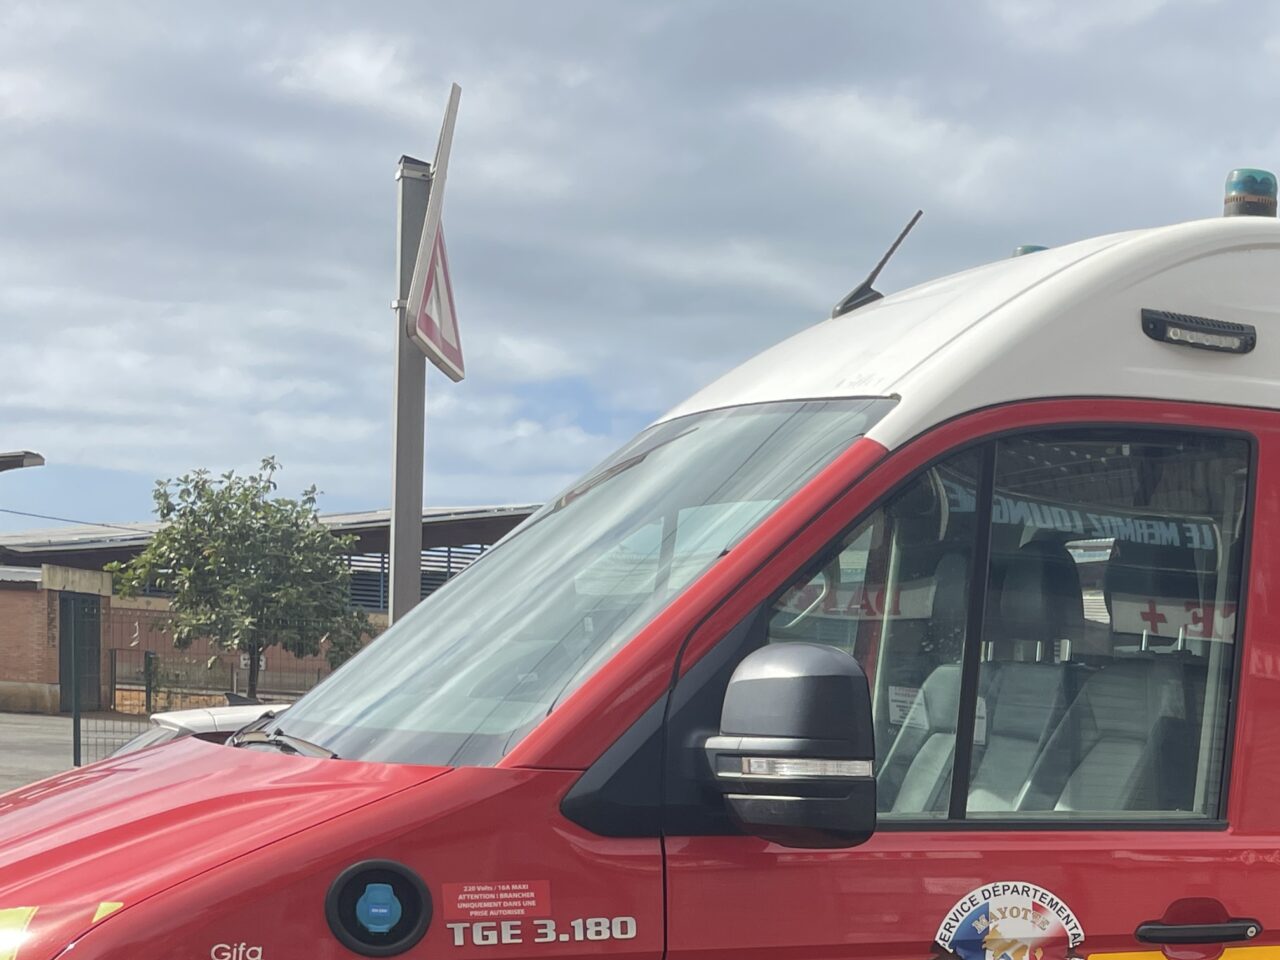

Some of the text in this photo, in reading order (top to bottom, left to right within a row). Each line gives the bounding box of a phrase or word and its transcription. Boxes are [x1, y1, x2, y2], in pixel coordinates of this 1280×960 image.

[458, 892, 495, 900] ATTENTION
[499, 891, 535, 899] BRANCHER
[503, 900, 522, 908] DANS
[470, 909, 488, 917] PRISE
[971, 905, 1050, 933] MAYOTTE
[446, 916, 637, 946] TGE 3.180
